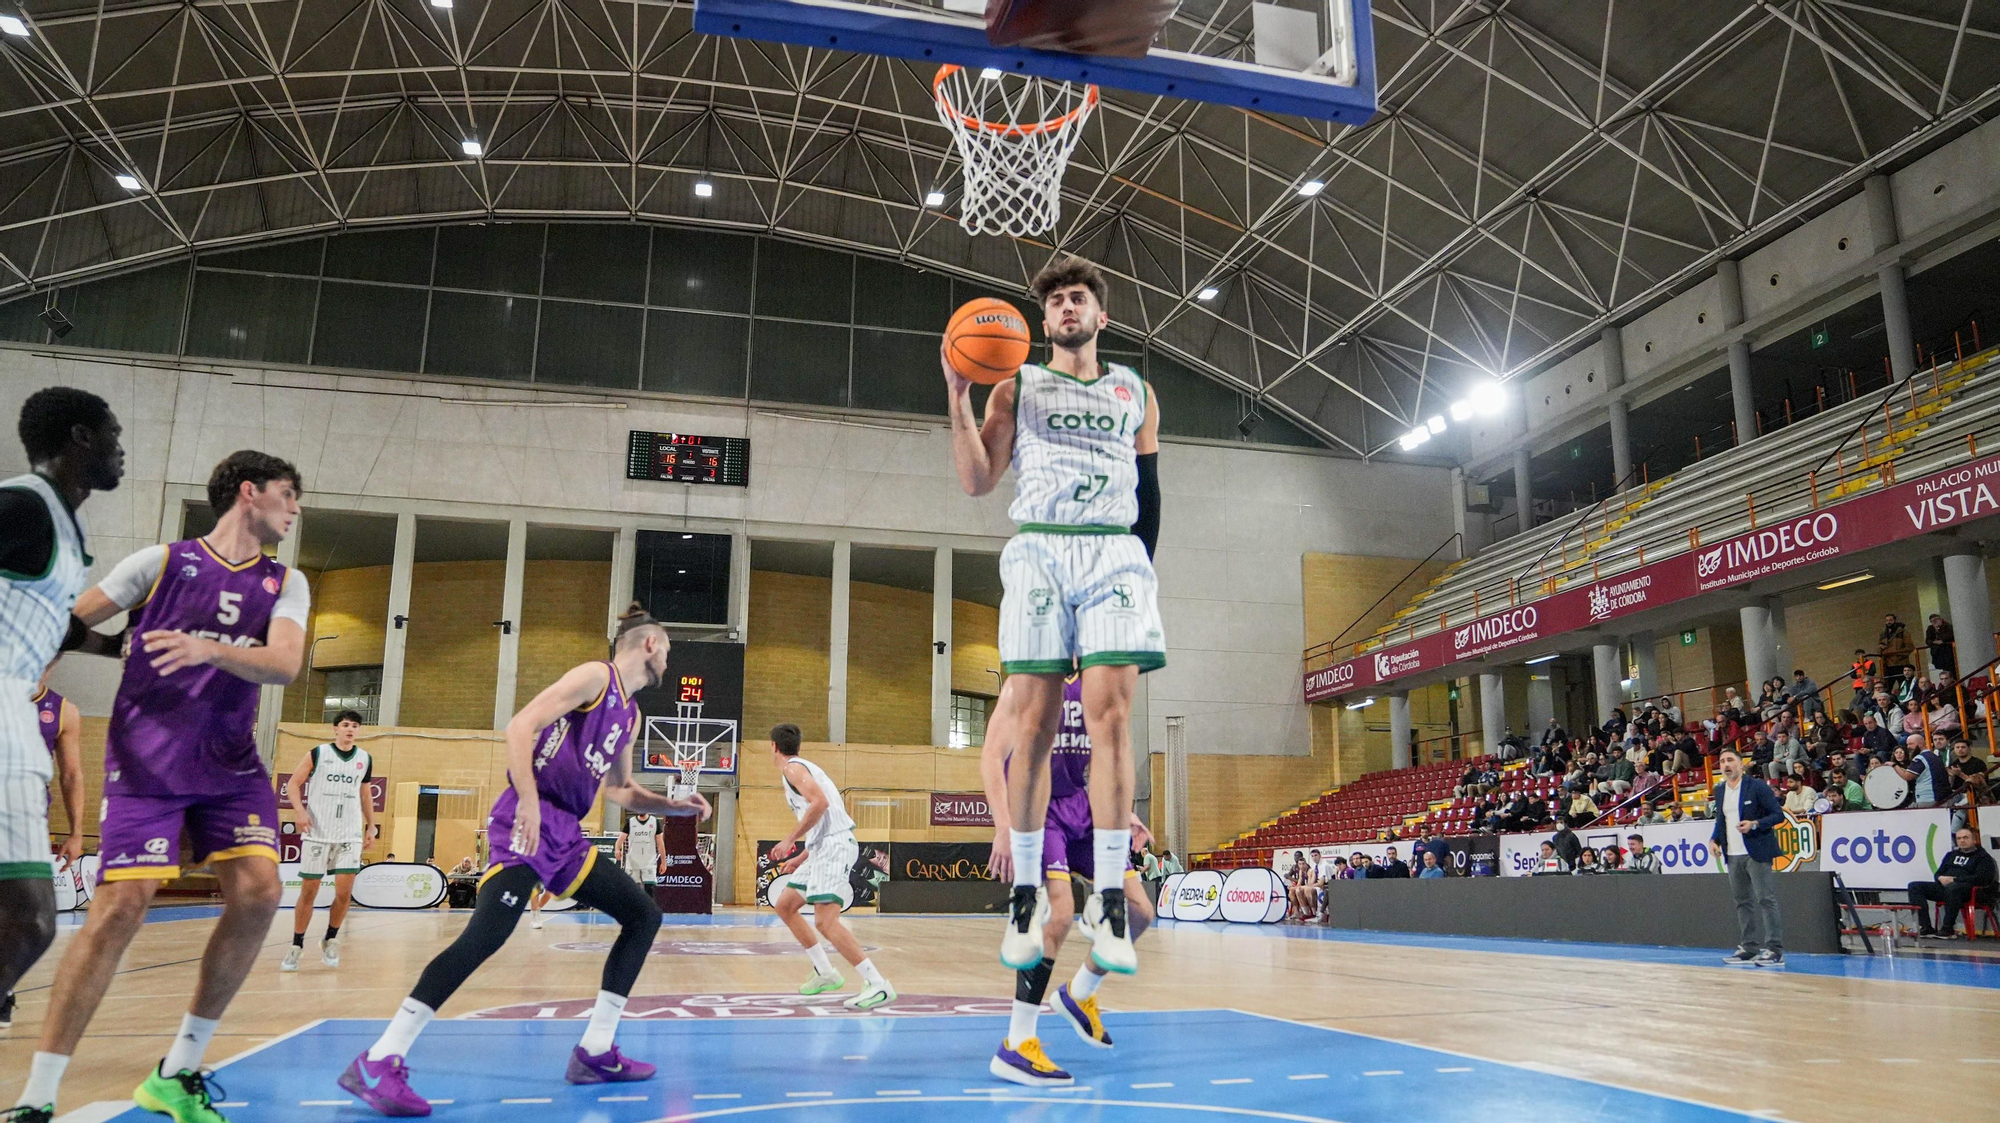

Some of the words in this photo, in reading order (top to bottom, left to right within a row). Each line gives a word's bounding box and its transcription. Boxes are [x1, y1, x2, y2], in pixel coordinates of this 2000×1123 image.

[1047, 411, 1115, 432] coto
[1073, 473, 1109, 504] 27
[1916, 470, 1971, 496] PALACIO
[1905, 483, 2000, 530] VISTA
[1726, 512, 1838, 569] IMDECO
[1700, 578, 1727, 590] Instituto
[1727, 567, 1760, 583] Municipal
[1761, 565, 1771, 574] de
[1771, 556, 1806, 571] Deportes
[1806, 546, 1840, 561] Córdoba
[1609, 575, 1651, 597] AYUNTAMIENTO
[216, 590, 243, 626] 5
[1610, 598, 1619, 610] DE
[1618, 590, 1647, 608] CÓRDOBA
[1471, 606, 1537, 645] IMDECO
[1684, 632, 1692, 644] B
[1390, 648, 1420, 665] Diputación
[1398, 660, 1421, 672] Córdoba
[1315, 664, 1354, 689] IMDECO
[680, 687, 702, 702] 24
[1063, 699, 1083, 727] 12
[327, 773, 353, 785] coto
[1831, 829, 1916, 864] coto
[1513, 851, 1539, 871] Sepi
[666, 875, 703, 885] IMDECO
[1180, 887, 1204, 901] PIEDRA
[1226, 887, 1265, 904] CÓRDOBA
